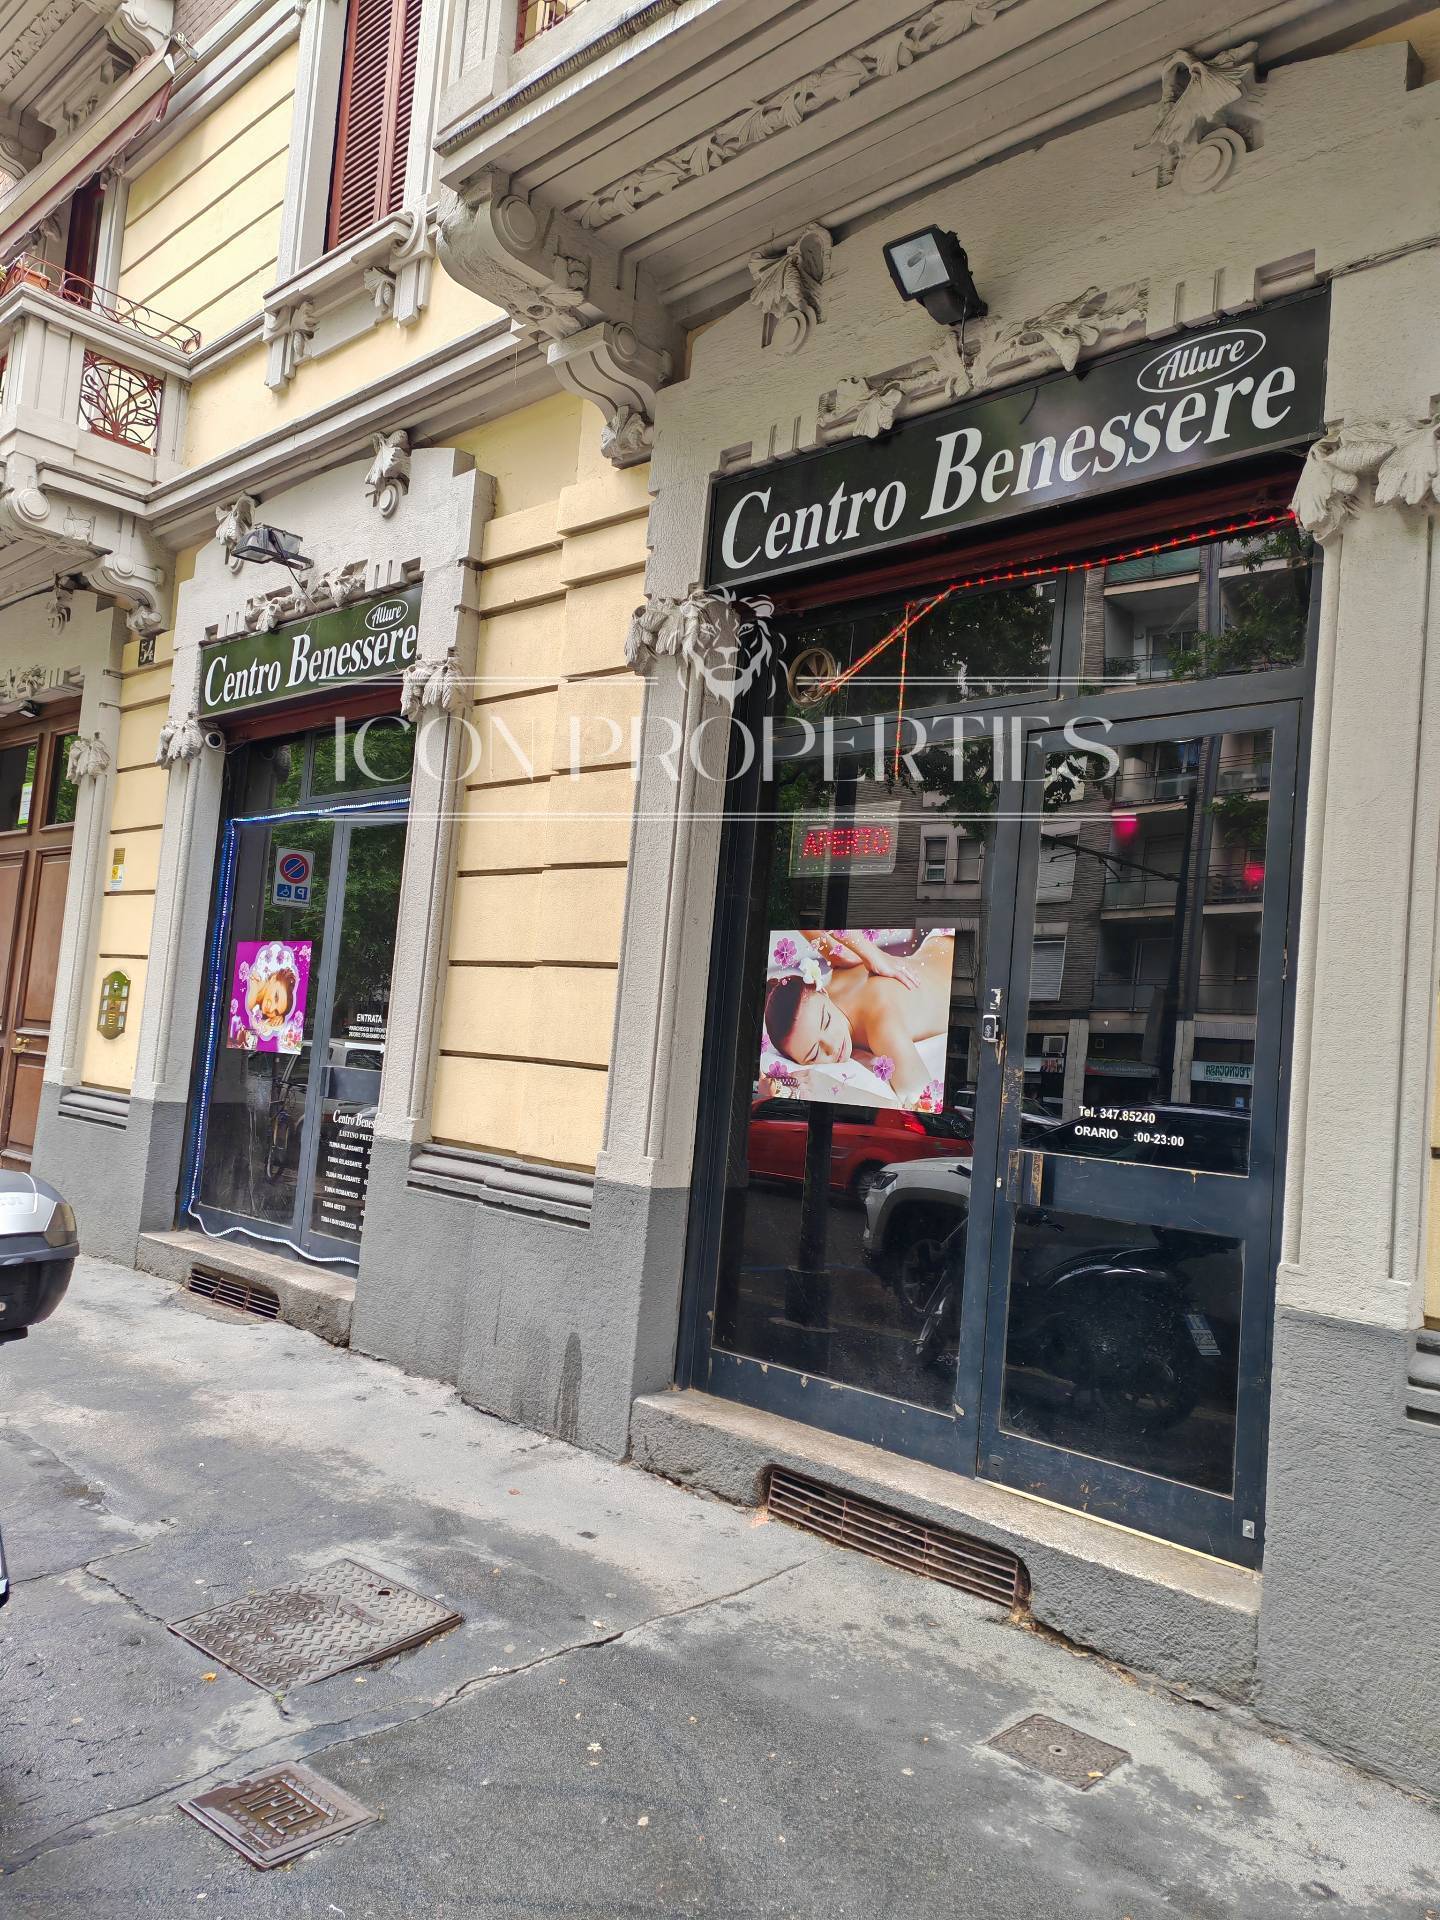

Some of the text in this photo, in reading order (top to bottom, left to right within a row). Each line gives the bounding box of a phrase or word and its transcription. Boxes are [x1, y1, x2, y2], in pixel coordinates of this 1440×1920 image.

[1156, 338, 1246, 389] Allure
[721, 366, 1297, 569] Centro Benessere
[371, 604, 403, 628] Allure
[204, 624, 417, 706] Centro Benessere
[803, 827, 890, 856] APERTO
[357, 1013, 382, 1023] ENTRATA
[333, 1109, 355, 1125] Centro
[1078, 1105, 1156, 1125] Tel. 347.85240
[338, 1129, 359, 1139] LISTINO
[1074, 1125, 1185, 1147] ORARIO :00-23:00
